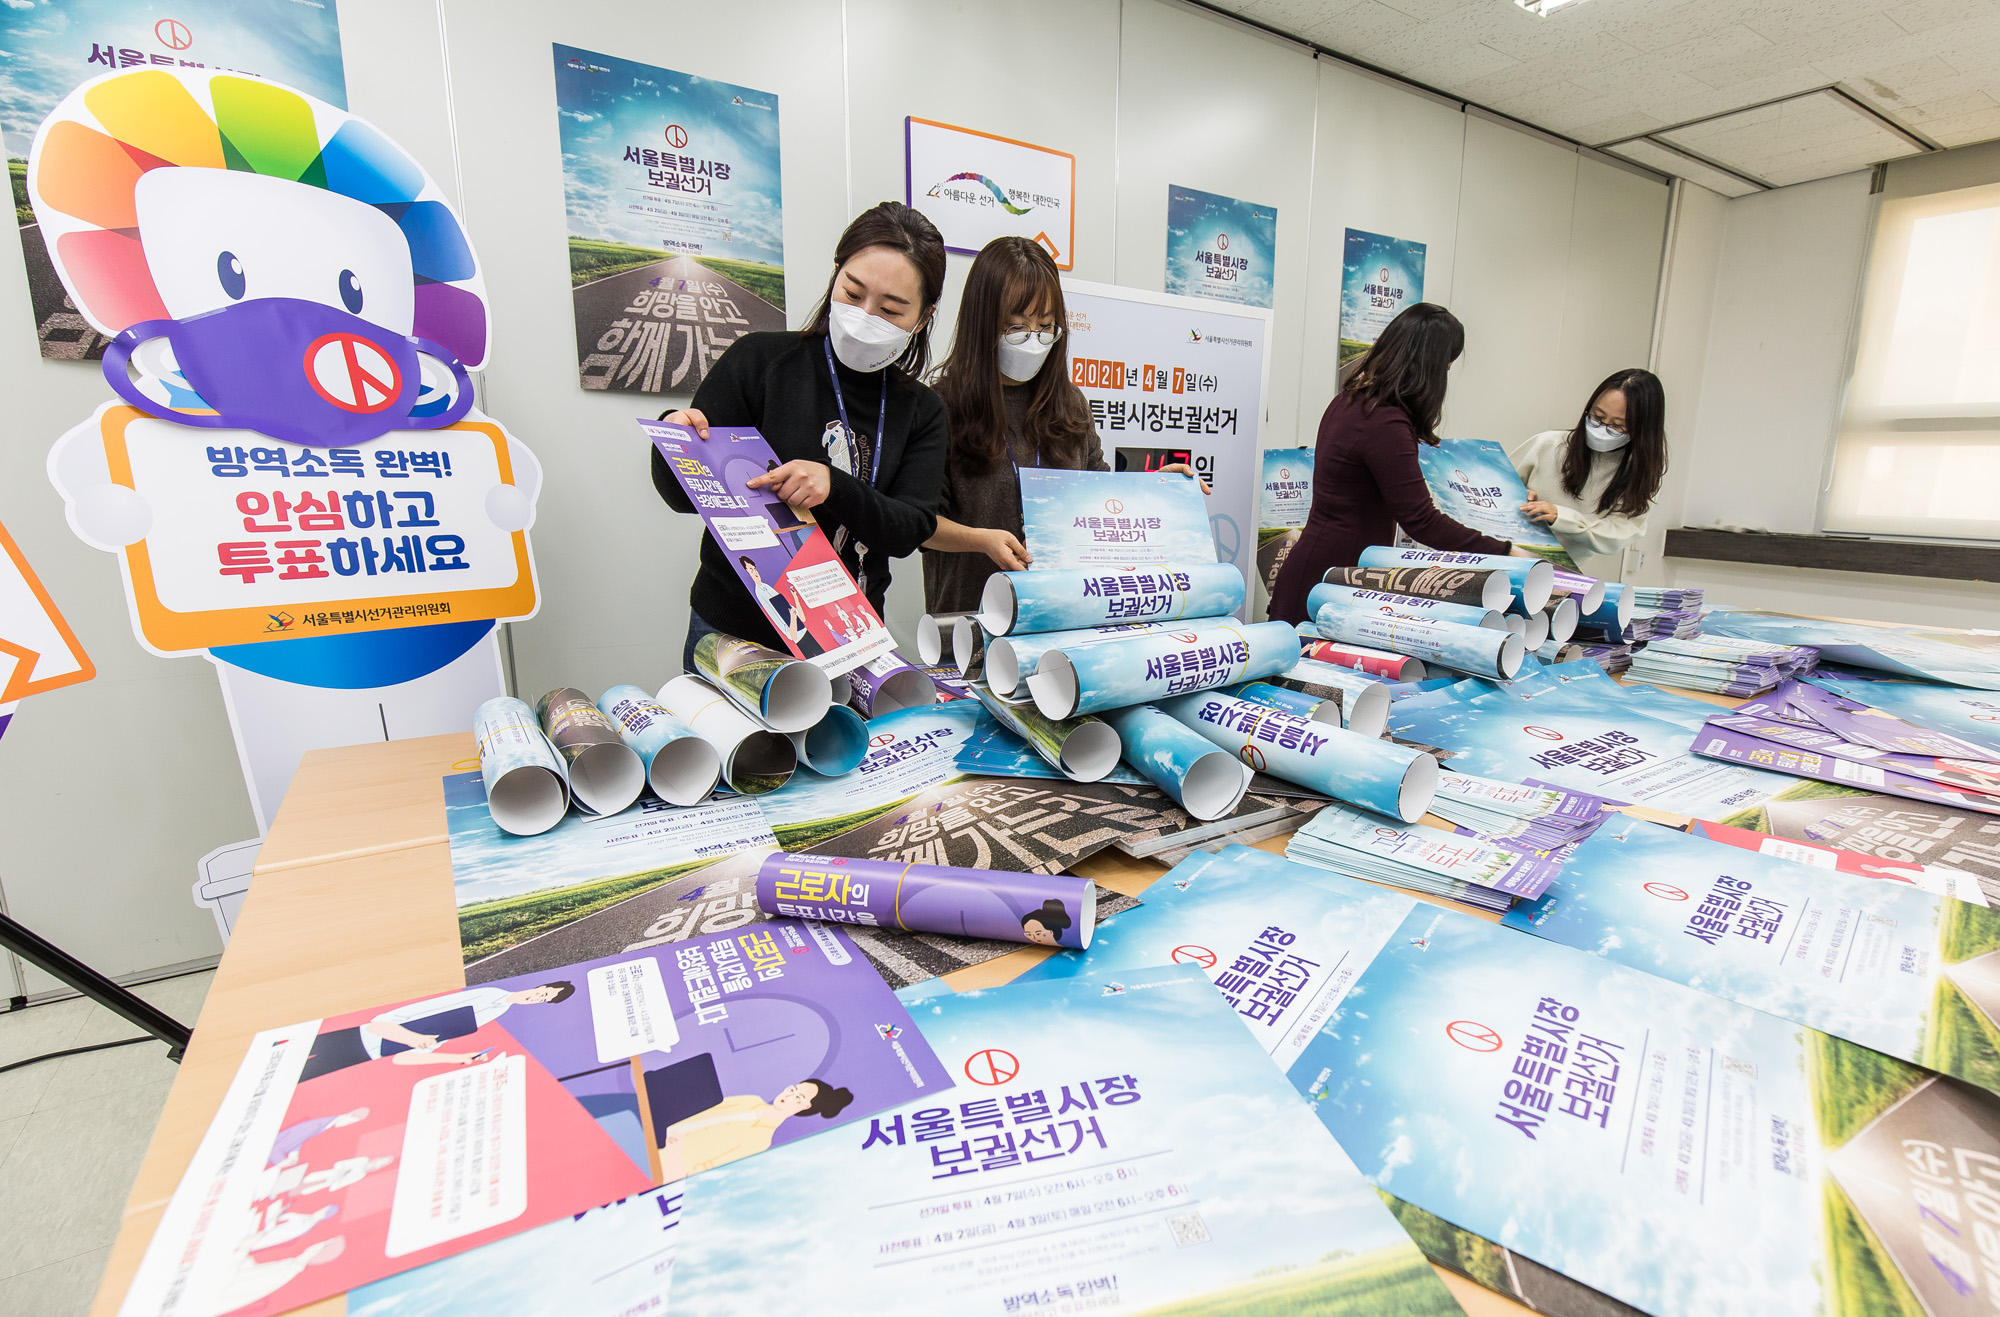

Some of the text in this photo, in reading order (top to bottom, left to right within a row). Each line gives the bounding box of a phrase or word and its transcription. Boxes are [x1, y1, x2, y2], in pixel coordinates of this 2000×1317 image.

[623, 145, 731, 181] 서울특별시장
[648, 168, 712, 196] 보궐선거
[944, 188, 1061, 210] 아름다운 선거 행복한 대한민국
[1195, 250, 1249, 271] 서울특별시장
[1206, 265, 1238, 282] 보궐선거
[649, 277, 728, 298] 4월 7일(수)
[1363, 283, 1404, 300] 서울특별시장
[1370, 296, 1395, 310] 보궐선거
[1076, 313, 1087, 322] 선거
[580, 318, 672, 393] 함께
[1205, 334, 1253, 348] 서울특별시선거관리위원회
[1074, 360, 1218, 394] 2021년 4월 7일(수)
[206, 446, 453, 479] 방역소독 완벽!
[1195, 455, 1215, 488] 일
[1265, 481, 1309, 491] 서울특별시장
[1275, 490, 1302, 500] 보궐선거
[1447, 480, 1503, 498] 서울특별시장
[235, 490, 441, 534] 안심하고
[1073, 516, 1162, 530] 서울특별시장
[1093, 529, 1147, 543] 보궐선거
[217, 534, 471, 585] 투표하세요
[1083, 572, 1192, 598] 서울특별시장
[302, 601, 452, 628] 서울특별시선거관리위원회
[1105, 594, 1173, 620] 보궐선거
[1145, 641, 1251, 682] 서울특별시장
[1162, 667, 1232, 698] 보궐선거
[1198, 700, 1330, 756] 서울특별시장
[860, 741, 939, 776] 보궐선거
[1529, 730, 1640, 770] 서울특별시장
[1578, 750, 1658, 776] 보궐선거
[893, 783, 1006, 827] 4월 7일(수)
[646, 829, 662, 837] 4월
[694, 838, 750, 855] 방역소독
[1426, 843, 1479, 869] 투표
[677, 878, 740, 901] 4월
[775, 868, 870, 907] 근로자의
[1683, 875, 1752, 946] 서울특별시장
[1733, 896, 1789, 944] 보궐선거
[706, 938, 754, 995] 투표시간을
[738, 930, 787, 982] 근로자의
[675, 948, 730, 1027] 보장해드립니다
[1239, 954, 1321, 1027] 보궐선거
[1495, 997, 1580, 1141] 서울특별시장
[1558, 1033, 1625, 1129] 보궐선거
[862, 1074, 1142, 1150] 서울특별시장
[931, 1116, 1108, 1180] 보궐선거
[919, 1203, 951, 1219] 선거일
[952, 1200, 973, 1211] 투표
[984, 1194, 1002, 1206] 4월
[1006, 1185, 1042, 1204] 7일(수)
[1043, 1181, 1065, 1195] 오전
[1116, 1166, 1138, 1182] 8시
[879, 1236, 923, 1255] 사전투표
[934, 1230, 954, 1244] 4월
[956, 1224, 996, 1242] 2일(금)
[1007, 1216, 1026, 1230] 4월
[1029, 1209, 1066, 1227] 3일(토)
[1069, 1204, 1091, 1219] 매일
[1093, 1199, 1115, 1214] 오전
[1168, 1182, 1189, 1197] 6시
[1002, 1275, 1118, 1313] 방역소독 완벽!
